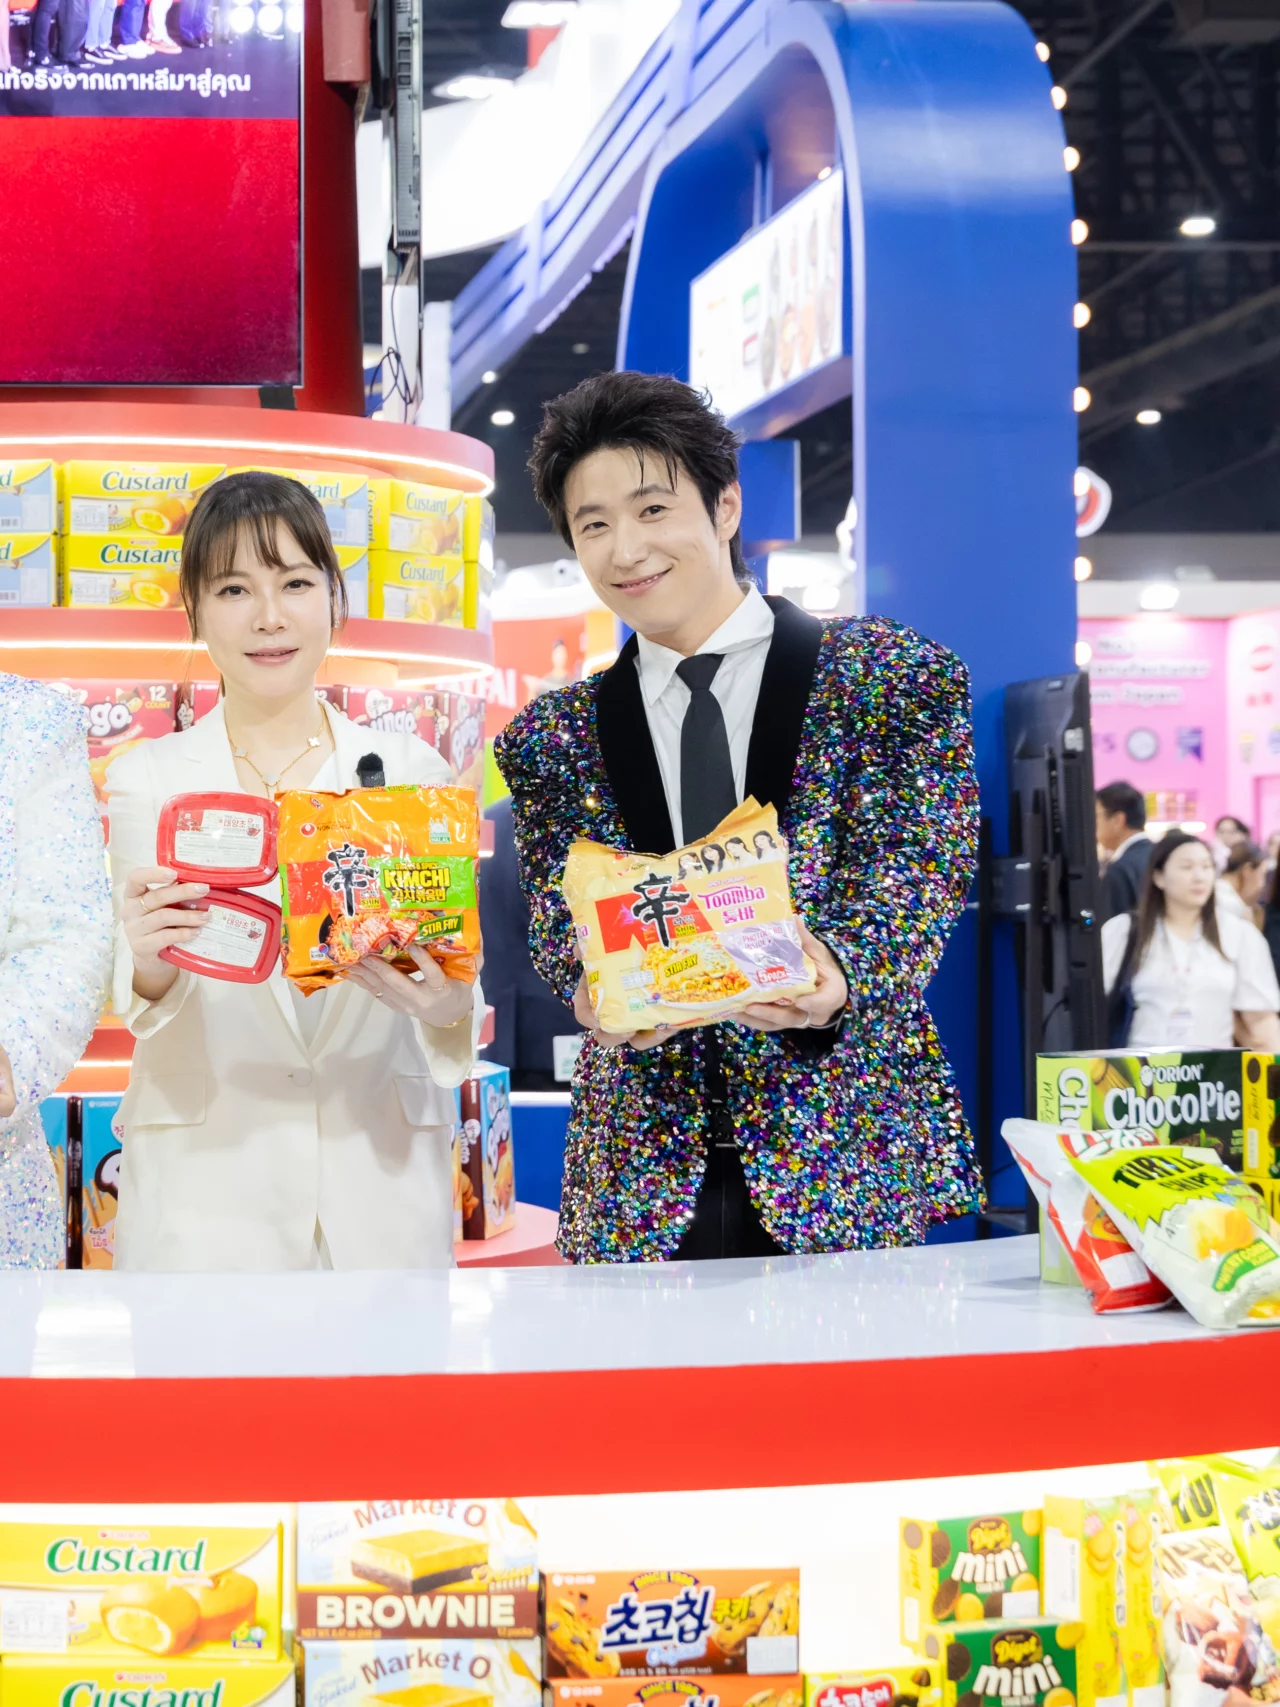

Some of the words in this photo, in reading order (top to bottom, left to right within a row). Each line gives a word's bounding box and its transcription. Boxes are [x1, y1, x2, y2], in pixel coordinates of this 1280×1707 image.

[102, 470, 189, 491] Custard
[406, 492, 448, 513] Custard
[401, 561, 446, 582] Custard
[149, 686, 166, 702] 12
[322, 842, 380, 918] 辛
[384, 868, 450, 888] KIMCHI
[631, 872, 690, 949] 辛
[697, 885, 765, 909] Toomba
[422, 922, 442, 937] STIR
[443, 917, 460, 933] FRY
[664, 962, 685, 978] STIR
[683, 954, 698, 969] FRY
[1154, 1066, 1202, 1084] ORION
[1104, 1081, 1241, 1130] ChocoPie
[353, 1500, 458, 1528] Market
[464, 1504, 487, 1527] O
[46, 1538, 207, 1574] Custard
[952, 1541, 1028, 1584] mini
[317, 1595, 516, 1628] BROWNIE
[602, 1587, 711, 1648] 초코칩
[713, 1597, 752, 1622] 쿠키
[361, 1647, 463, 1684] Market
[468, 1657, 492, 1680] O
[973, 1655, 1063, 1696] mini
[61, 1680, 225, 1707] Custard
